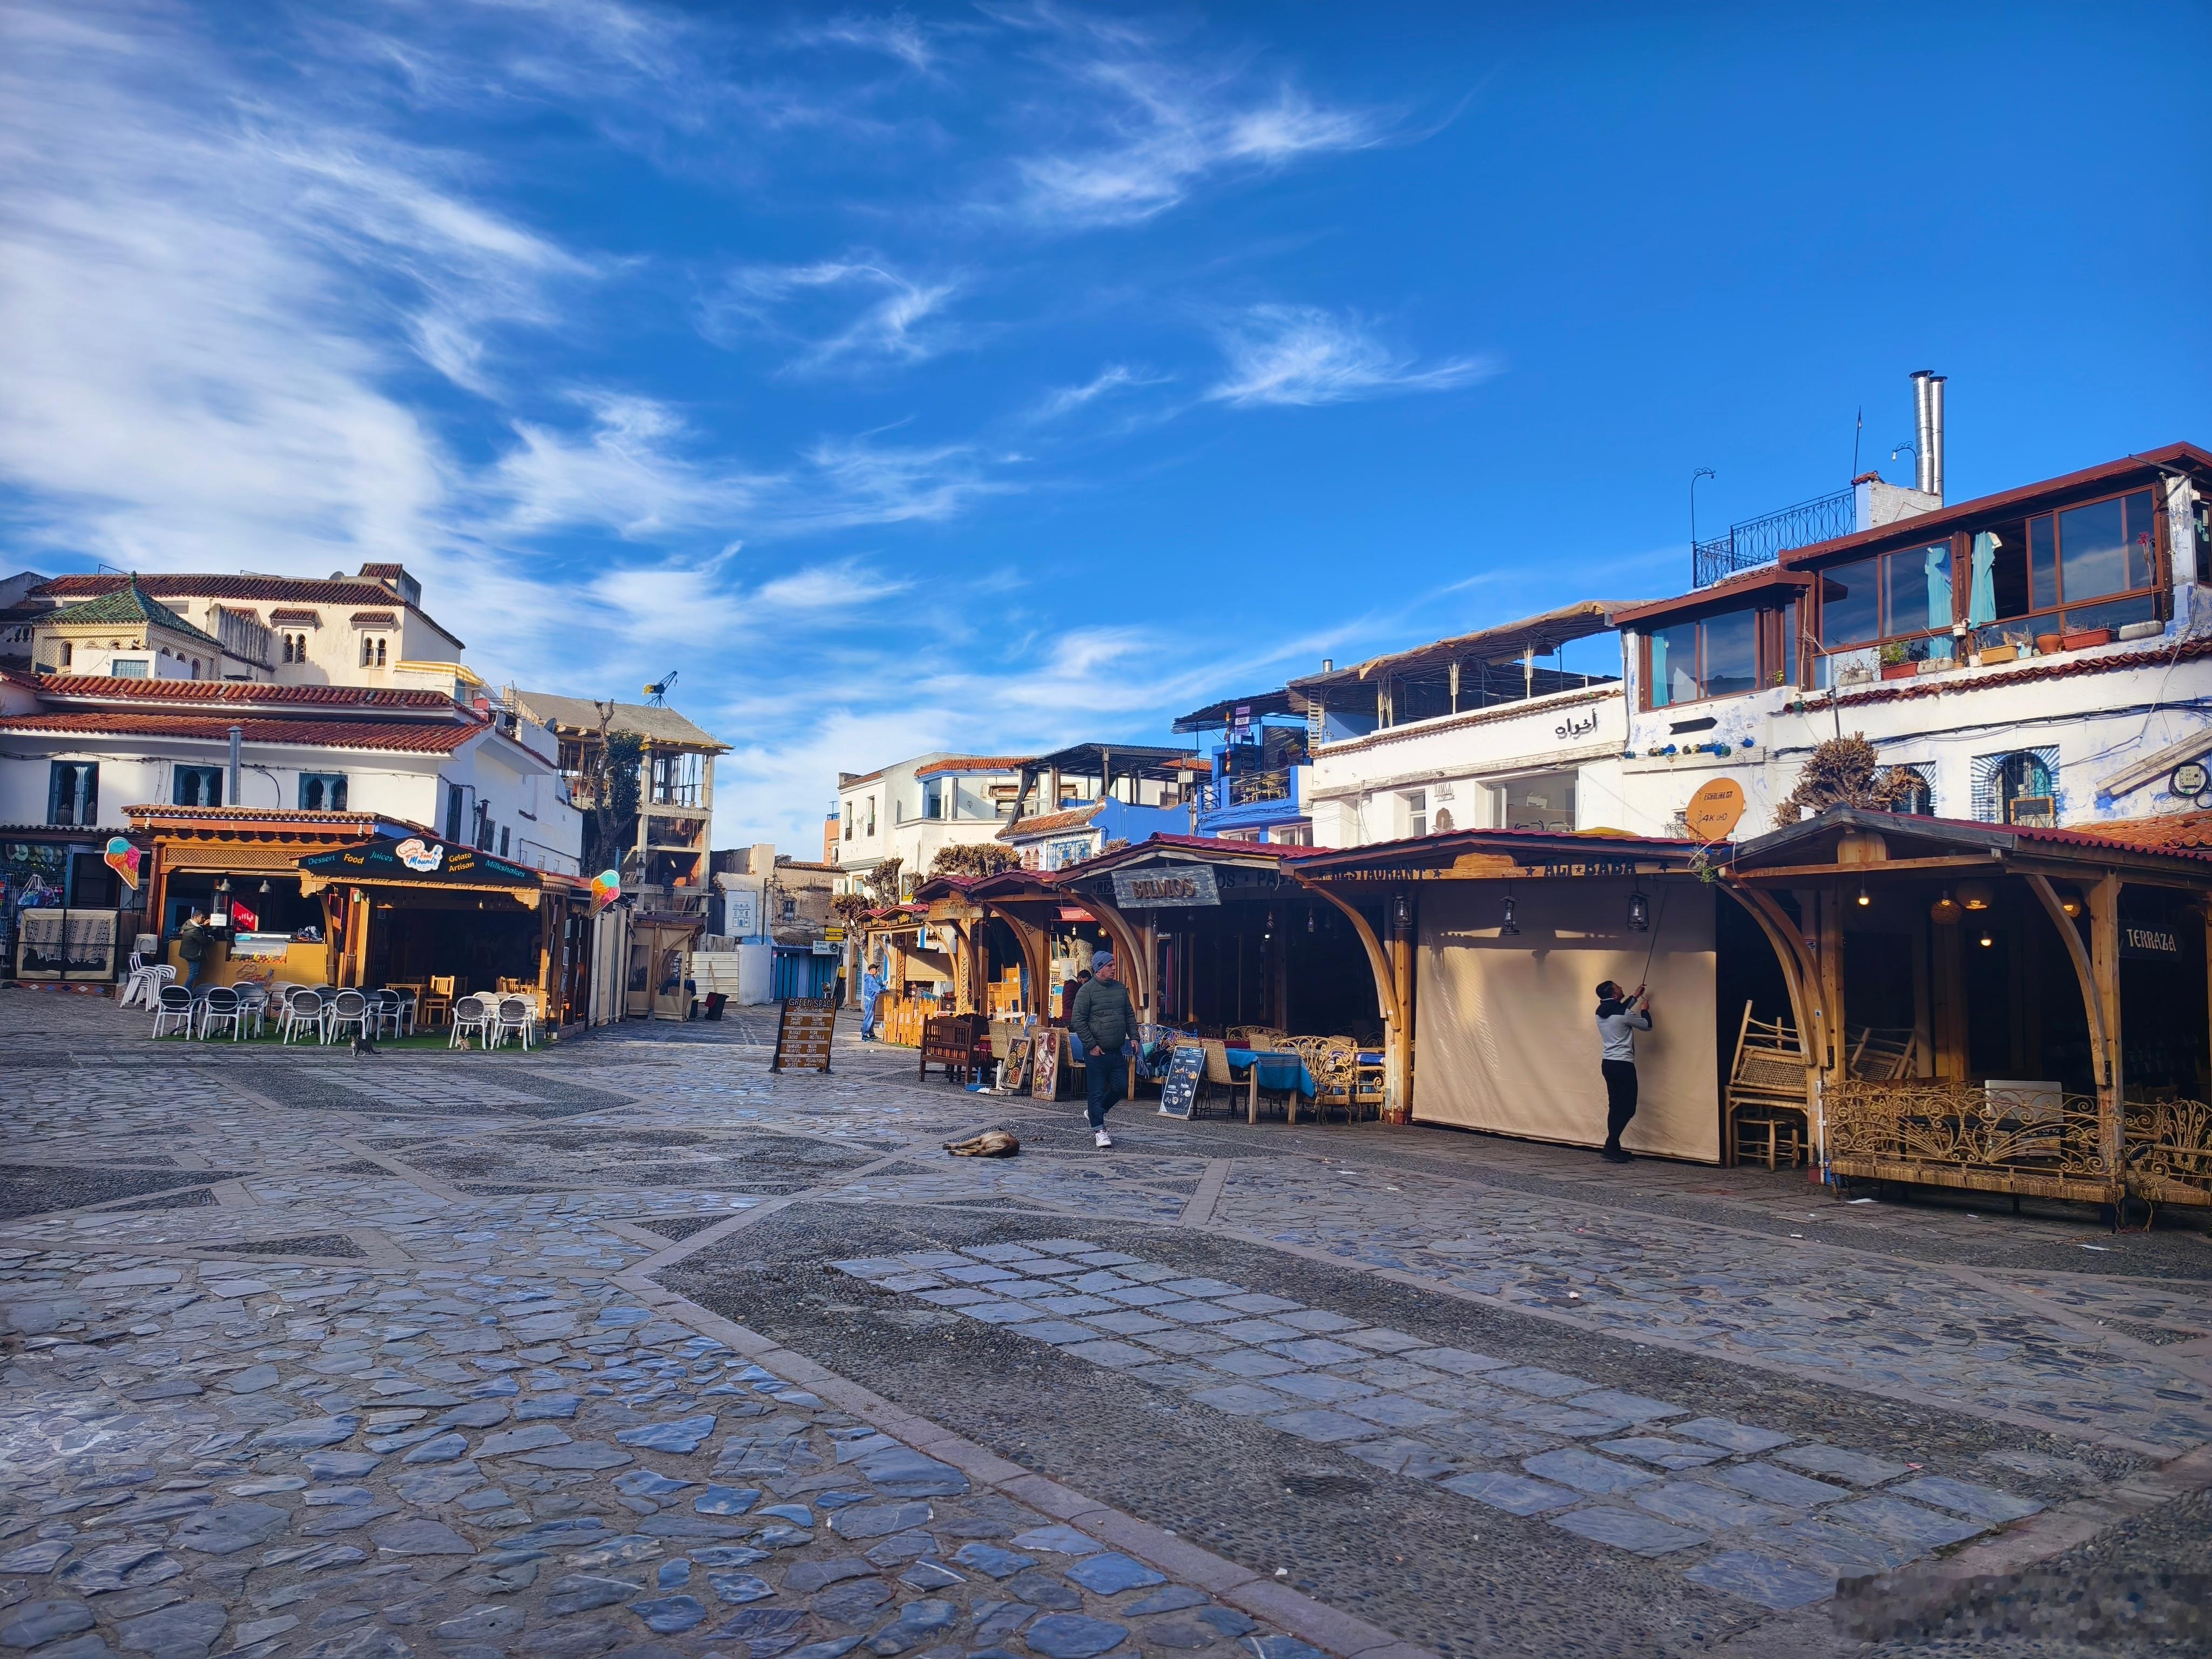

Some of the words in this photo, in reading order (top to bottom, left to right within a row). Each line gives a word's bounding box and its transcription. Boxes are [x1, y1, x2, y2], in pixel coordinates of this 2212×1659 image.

[308, 855, 335, 865] Dessert
[343, 853, 365, 865] Food
[369, 851, 394, 862] Juices
[449, 853, 471, 862] Gelato
[449, 862, 474, 872] Artisan
[485, 860, 525, 878] Milkshakes
[1131, 878, 1196, 899] BILMOS
[2126, 929, 2176, 952] TERRAZA
[788, 998, 812, 1007] GREEN
[814, 999, 834, 1008] SPACE
